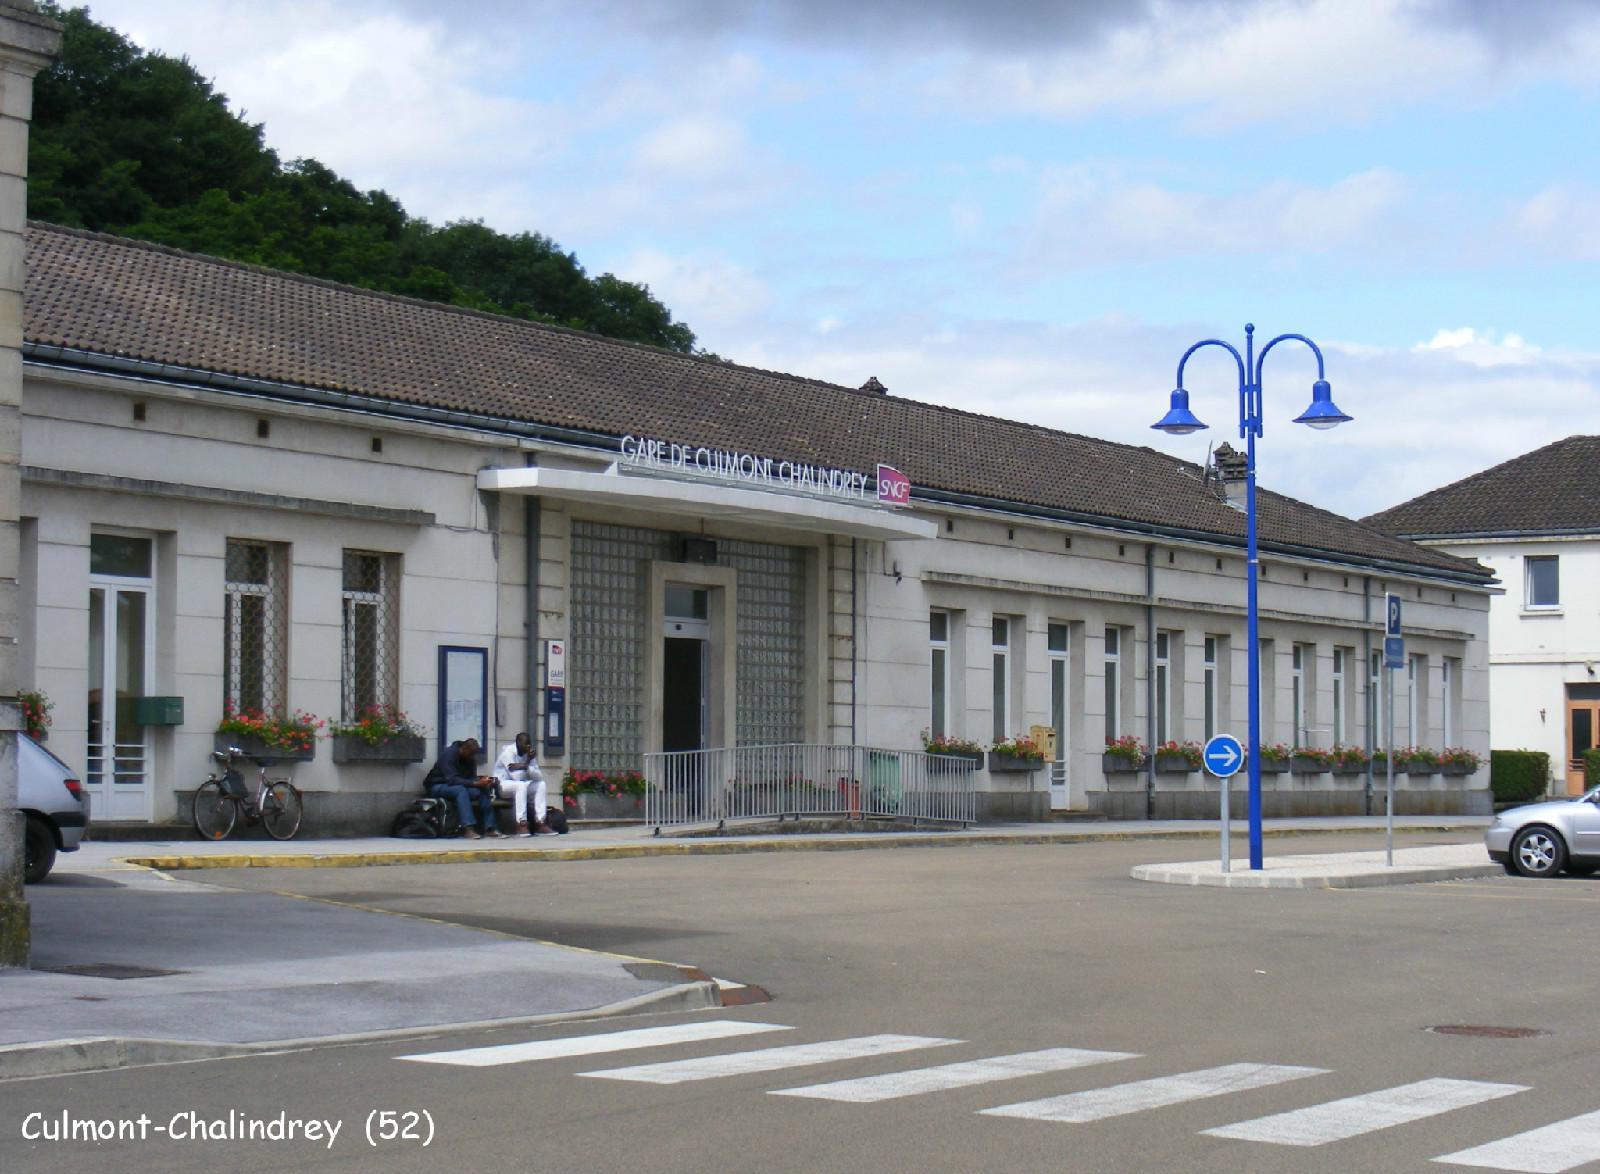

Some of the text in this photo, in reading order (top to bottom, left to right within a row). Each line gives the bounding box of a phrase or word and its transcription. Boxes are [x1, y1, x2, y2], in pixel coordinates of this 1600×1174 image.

[621, 435, 868, 500] GARE DE CULMONT CHALINDREY
[879, 479, 910, 499] SNCF
[1391, 602, 1398, 628] P
